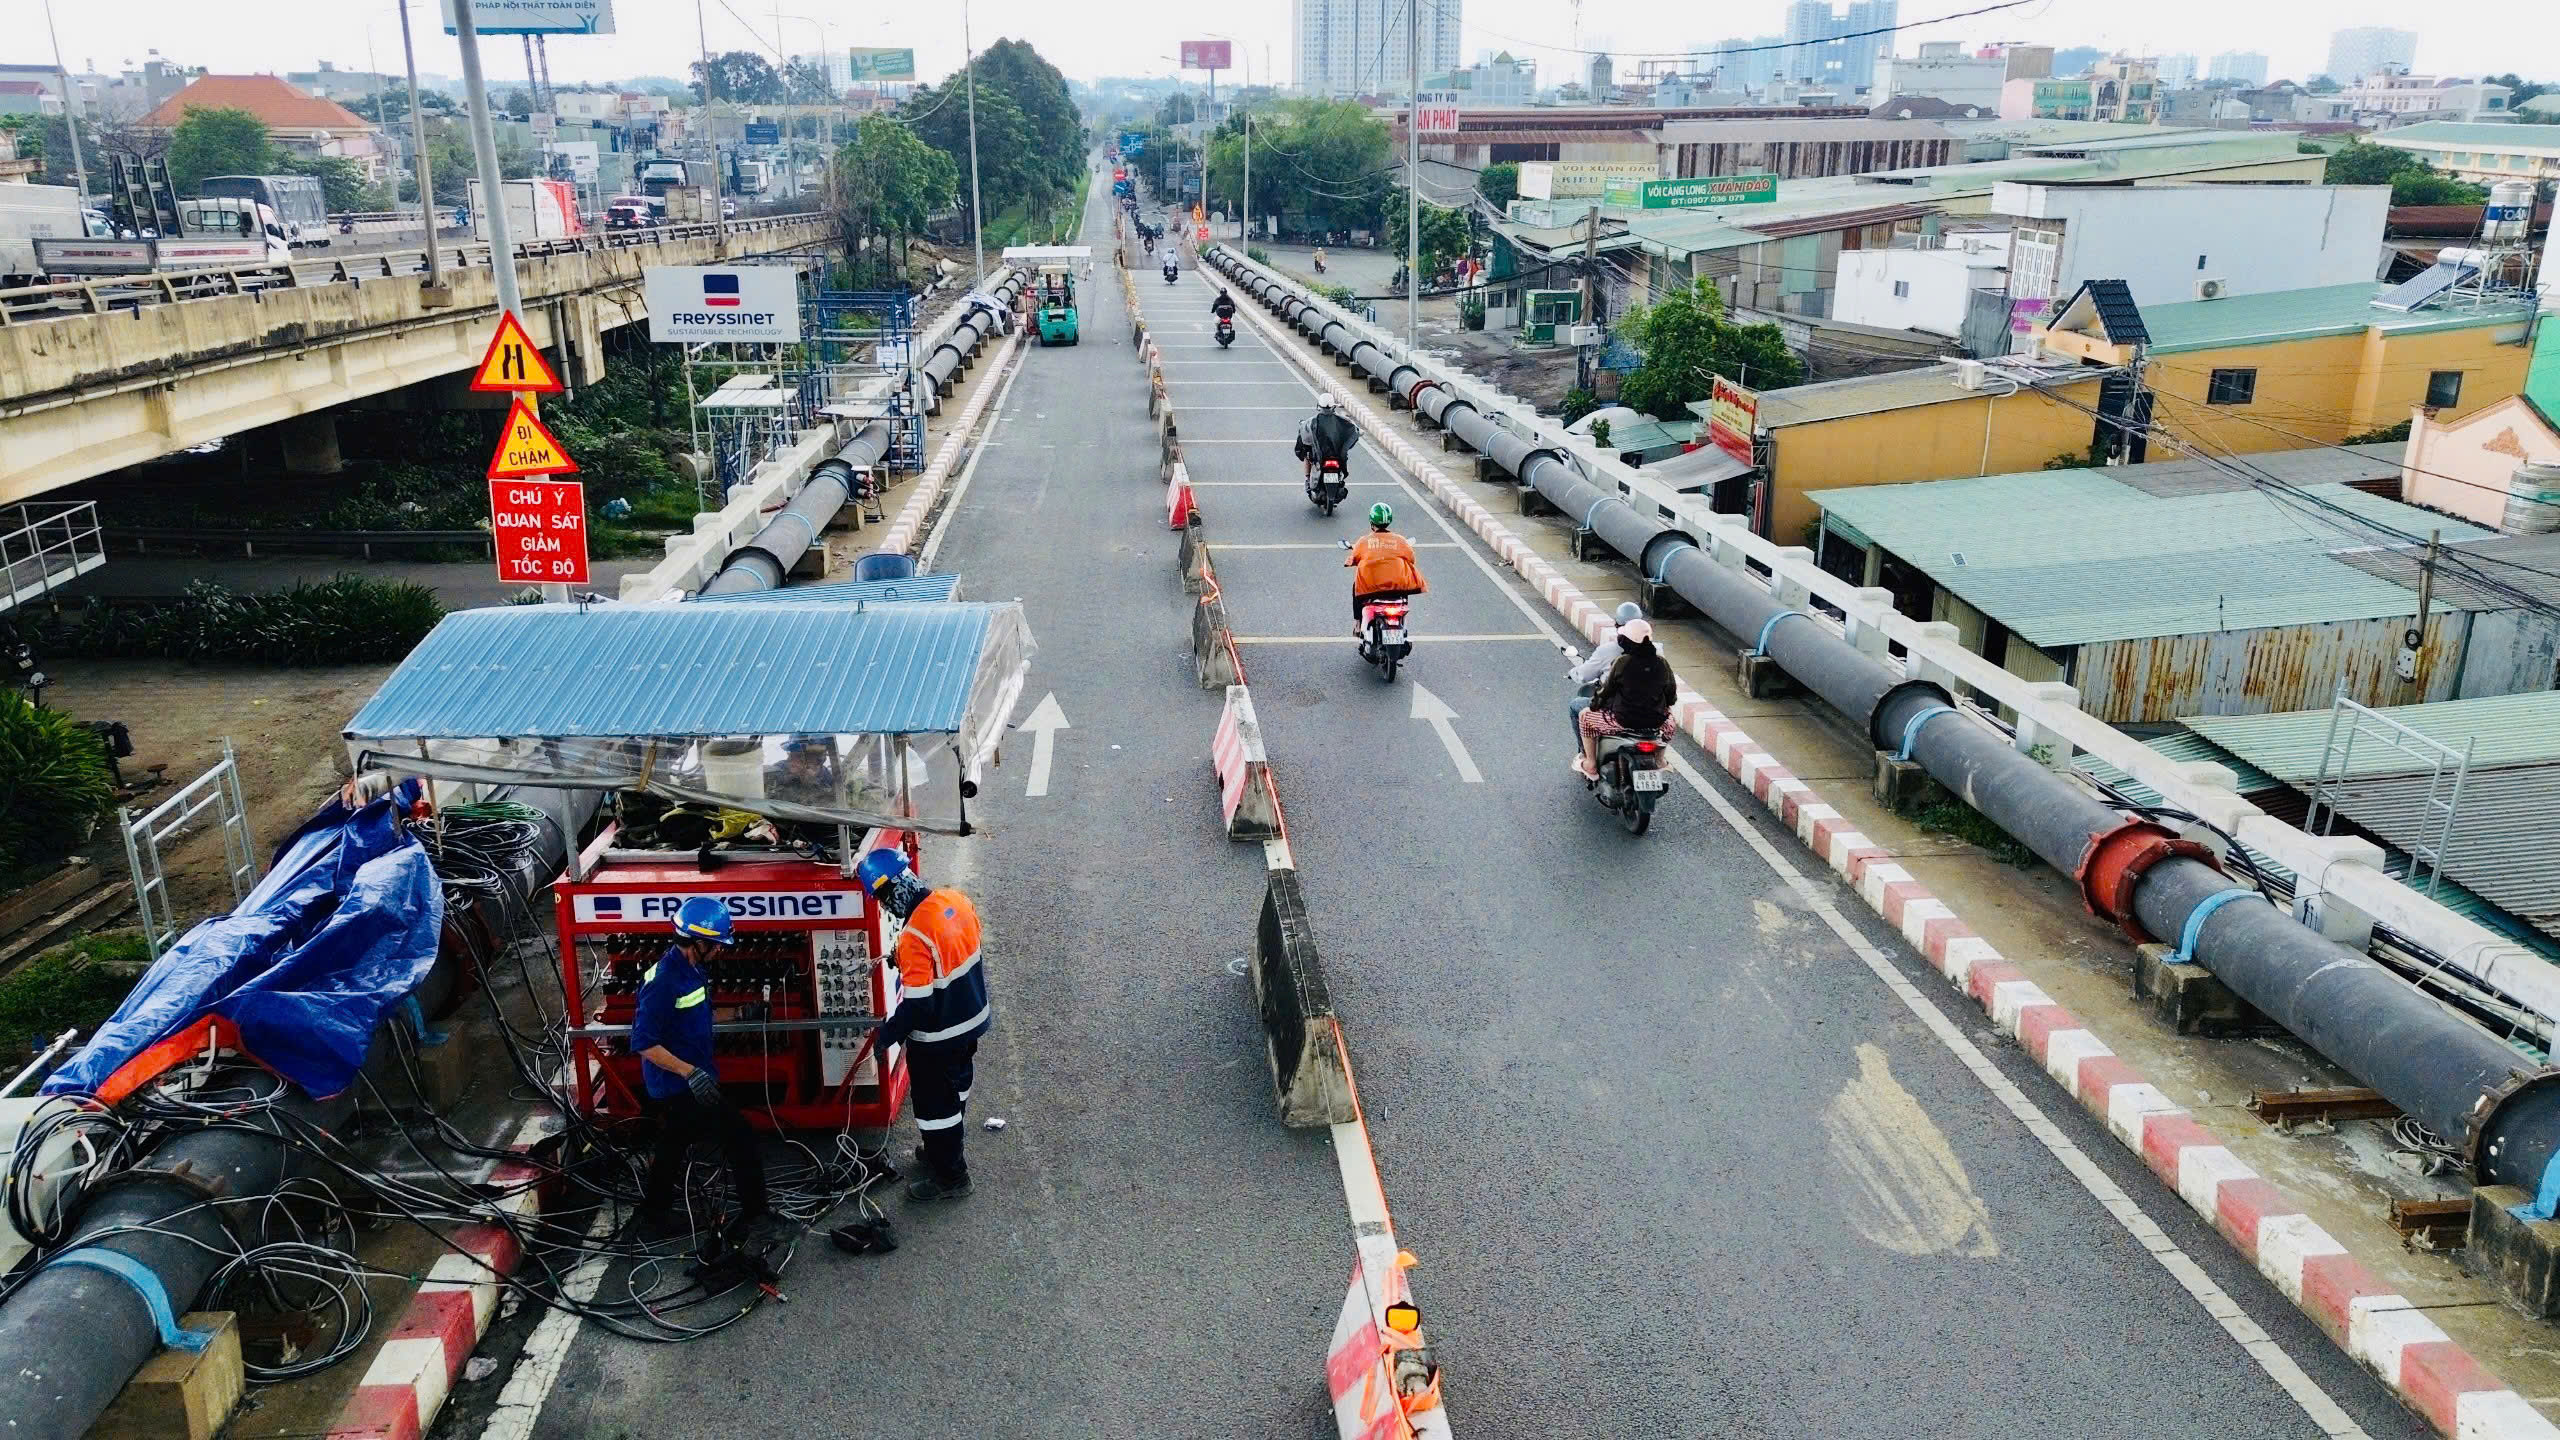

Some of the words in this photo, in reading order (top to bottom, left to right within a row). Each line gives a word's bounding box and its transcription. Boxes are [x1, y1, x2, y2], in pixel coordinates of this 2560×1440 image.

[1435, 93, 1443, 102] TY
[1686, 184, 1707, 195] LONG
[509, 488, 542, 505] CHÚ
[554, 487, 565, 506] Ý
[497, 513, 541, 528] QUAN
[551, 512, 580, 530] SÁT
[521, 535, 561, 552] GIẢM
[511, 555, 543, 575] TỐC
[552, 557, 575, 578] ĐỘ
